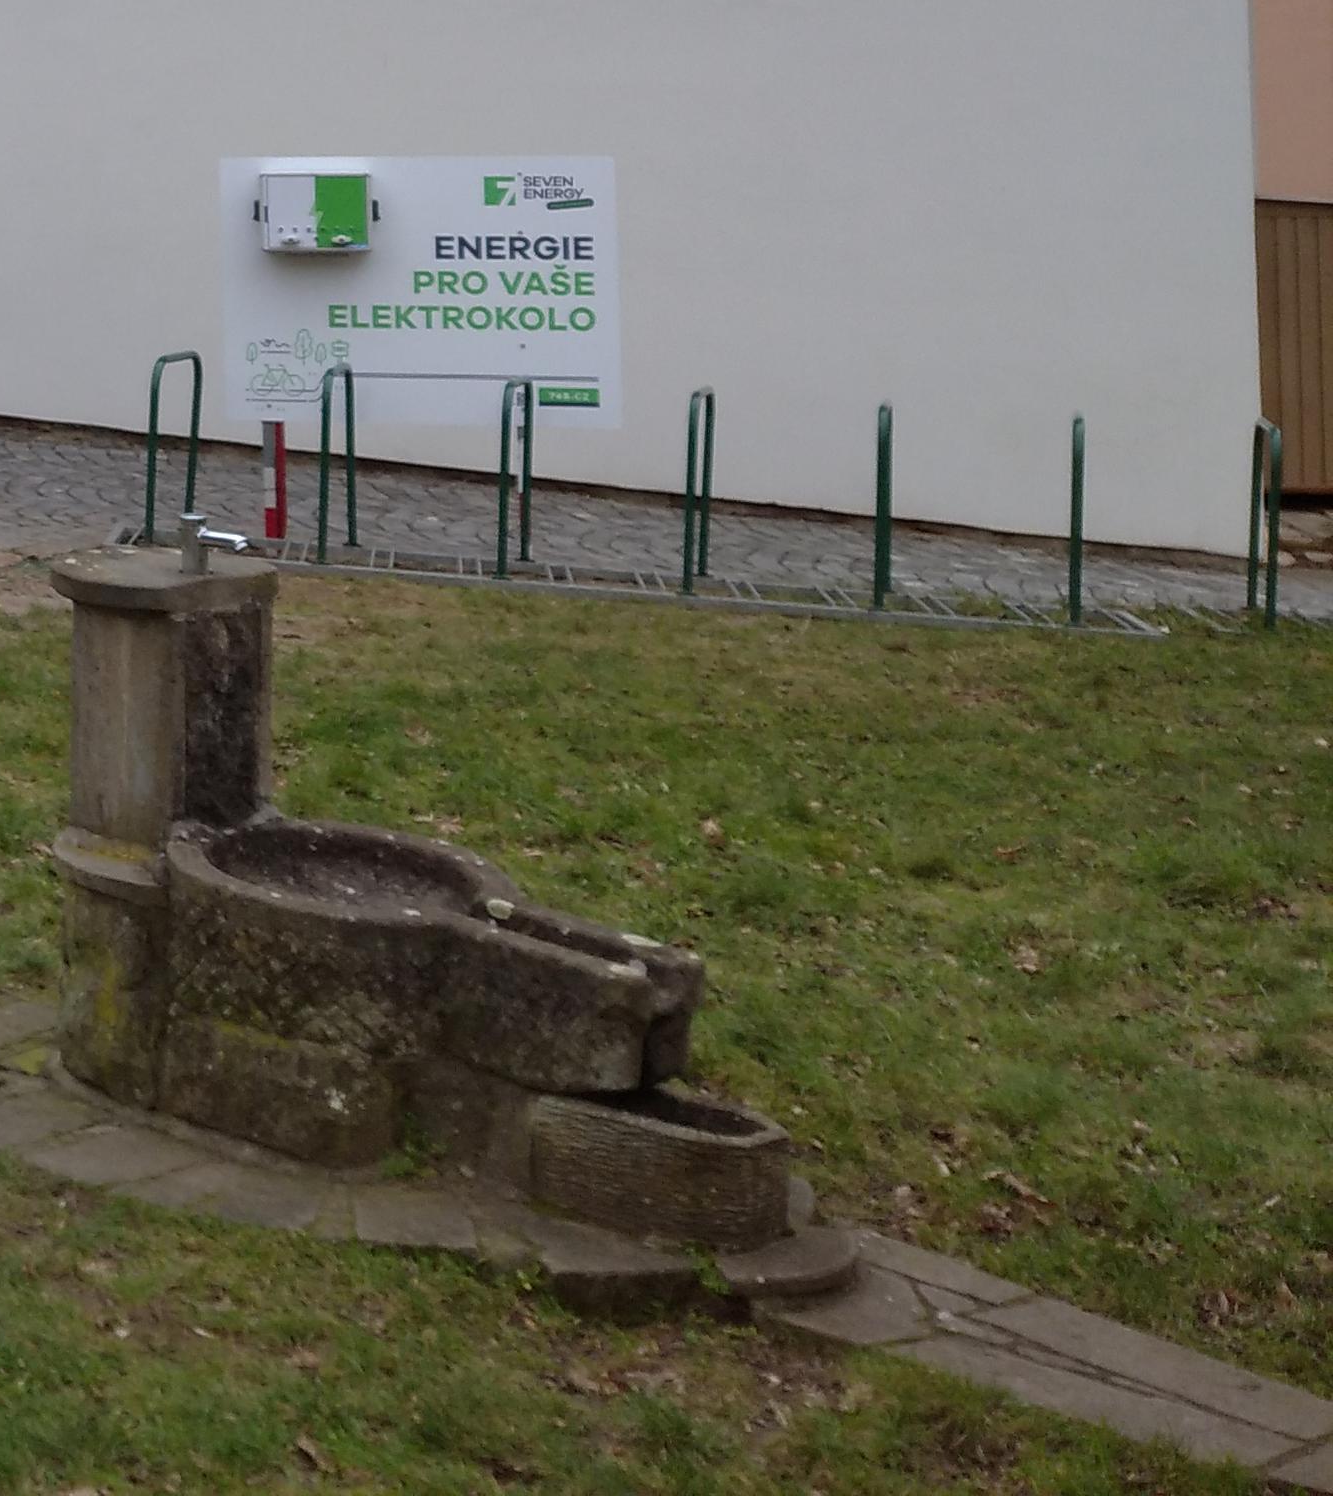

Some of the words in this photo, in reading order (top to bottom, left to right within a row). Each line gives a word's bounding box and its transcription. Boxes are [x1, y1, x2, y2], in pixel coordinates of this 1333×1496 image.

[523, 176, 574, 187] SEVEN
[523, 188, 585, 200] ENERGY
[434, 235, 595, 261] ENERGIE
[413, 270, 488, 295] PRO
[499, 264, 595, 296] VAŠE
[328, 304, 596, 332] ELEKTROKOLO
